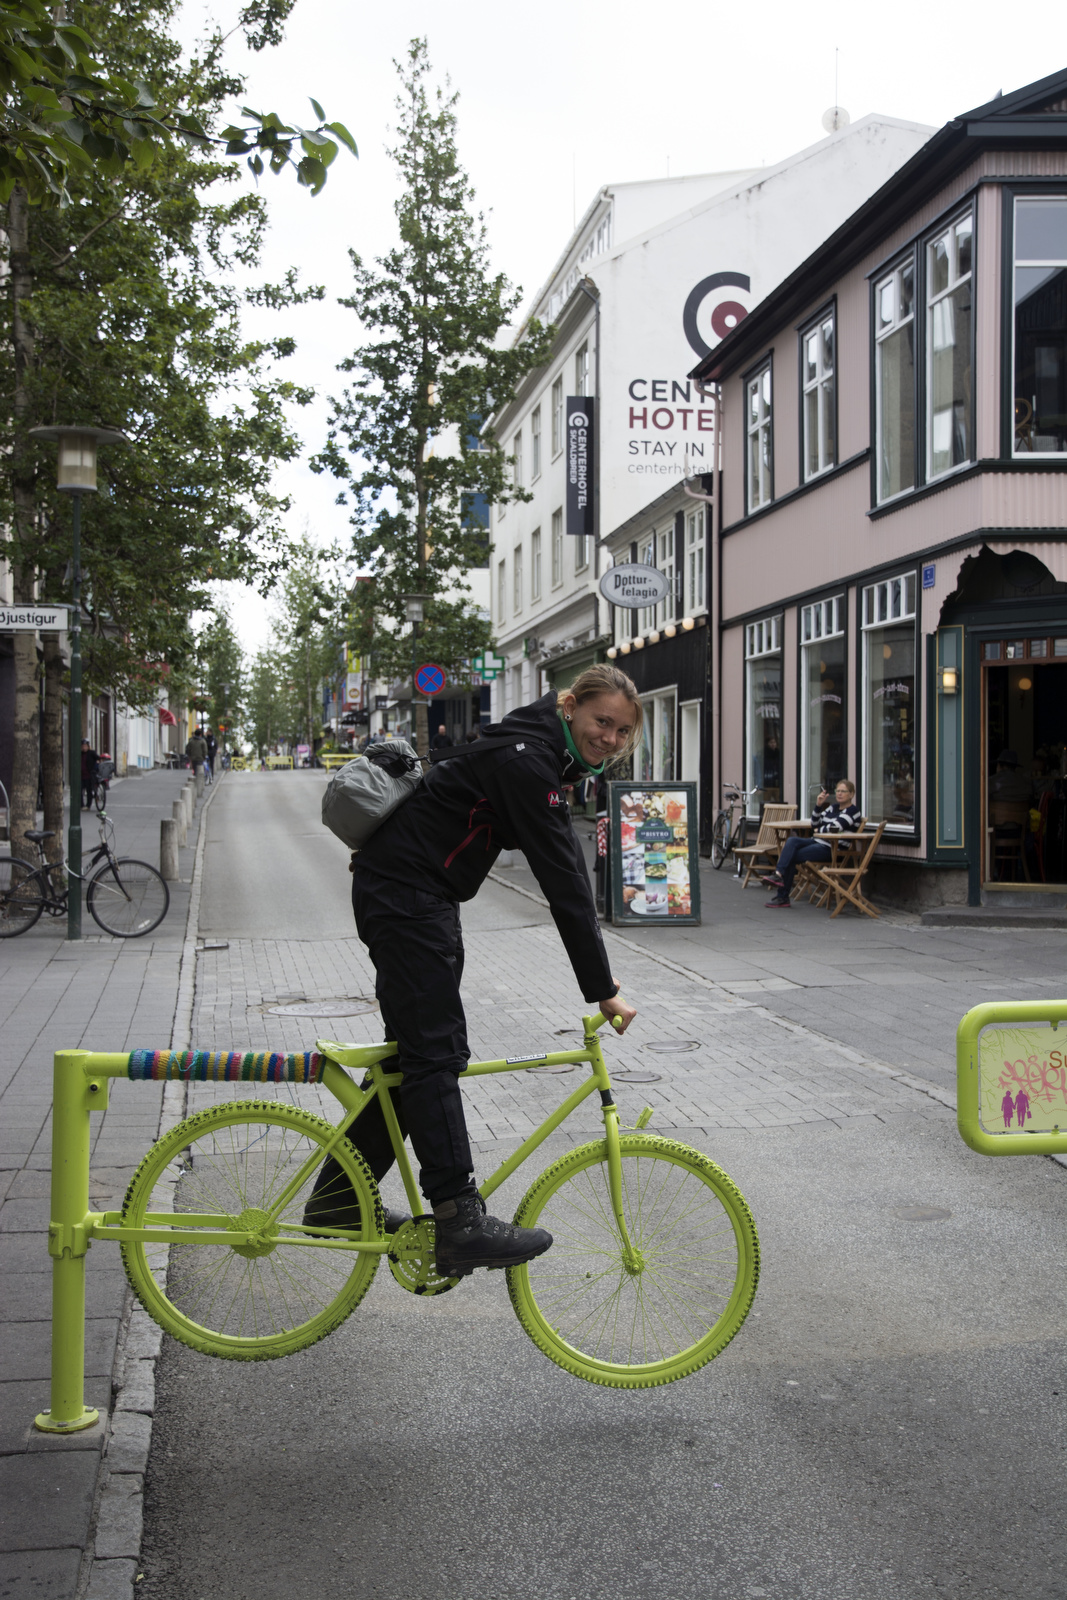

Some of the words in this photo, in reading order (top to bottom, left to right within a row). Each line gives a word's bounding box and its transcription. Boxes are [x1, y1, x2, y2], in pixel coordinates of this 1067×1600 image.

[628, 379, 721, 403] CENT
[629, 407, 721, 431] HOTE
[628, 440, 677, 456] STAY
[685, 442, 704, 457] IN
[578, 428, 587, 509] CENTERHOTEL
